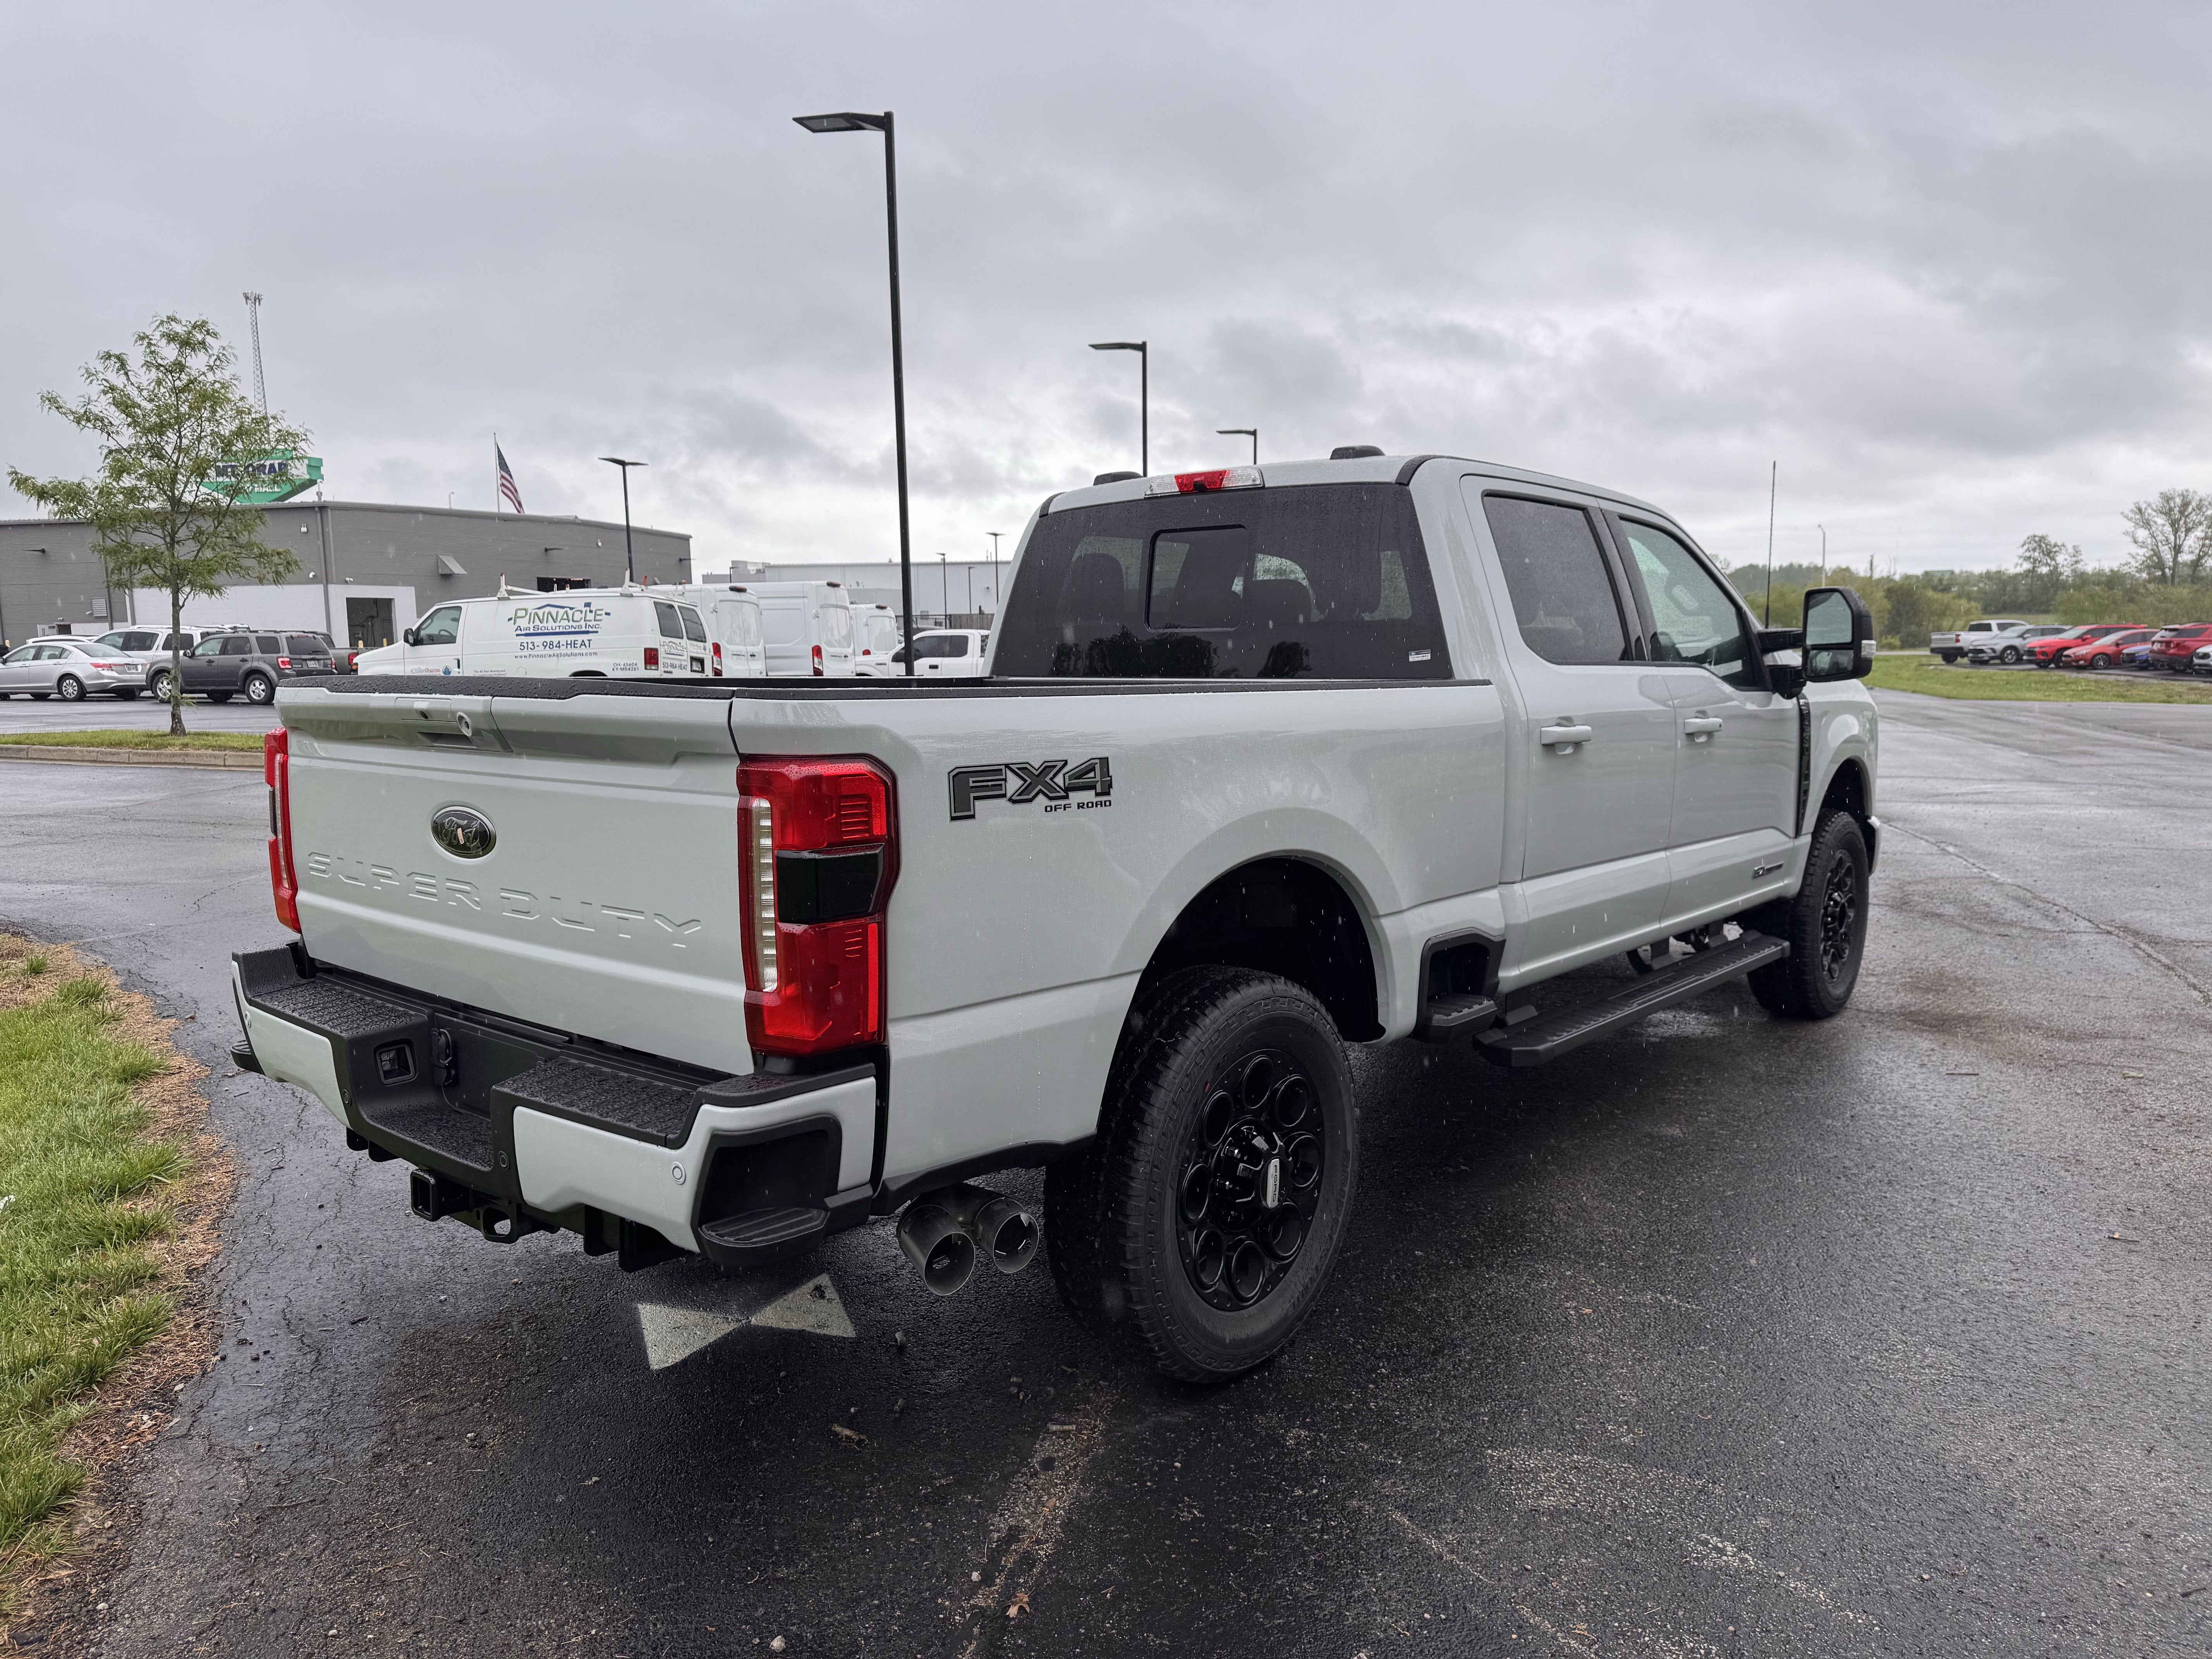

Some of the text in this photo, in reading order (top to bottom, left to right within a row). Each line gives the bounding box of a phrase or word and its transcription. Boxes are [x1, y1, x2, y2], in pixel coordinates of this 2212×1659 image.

[514, 608, 604, 625] PINNACLE
[947, 756, 1112, 822] FX4
[1044, 800, 1111, 812] OFF ROAD
[308, 852, 701, 948] SUPER DUTY
